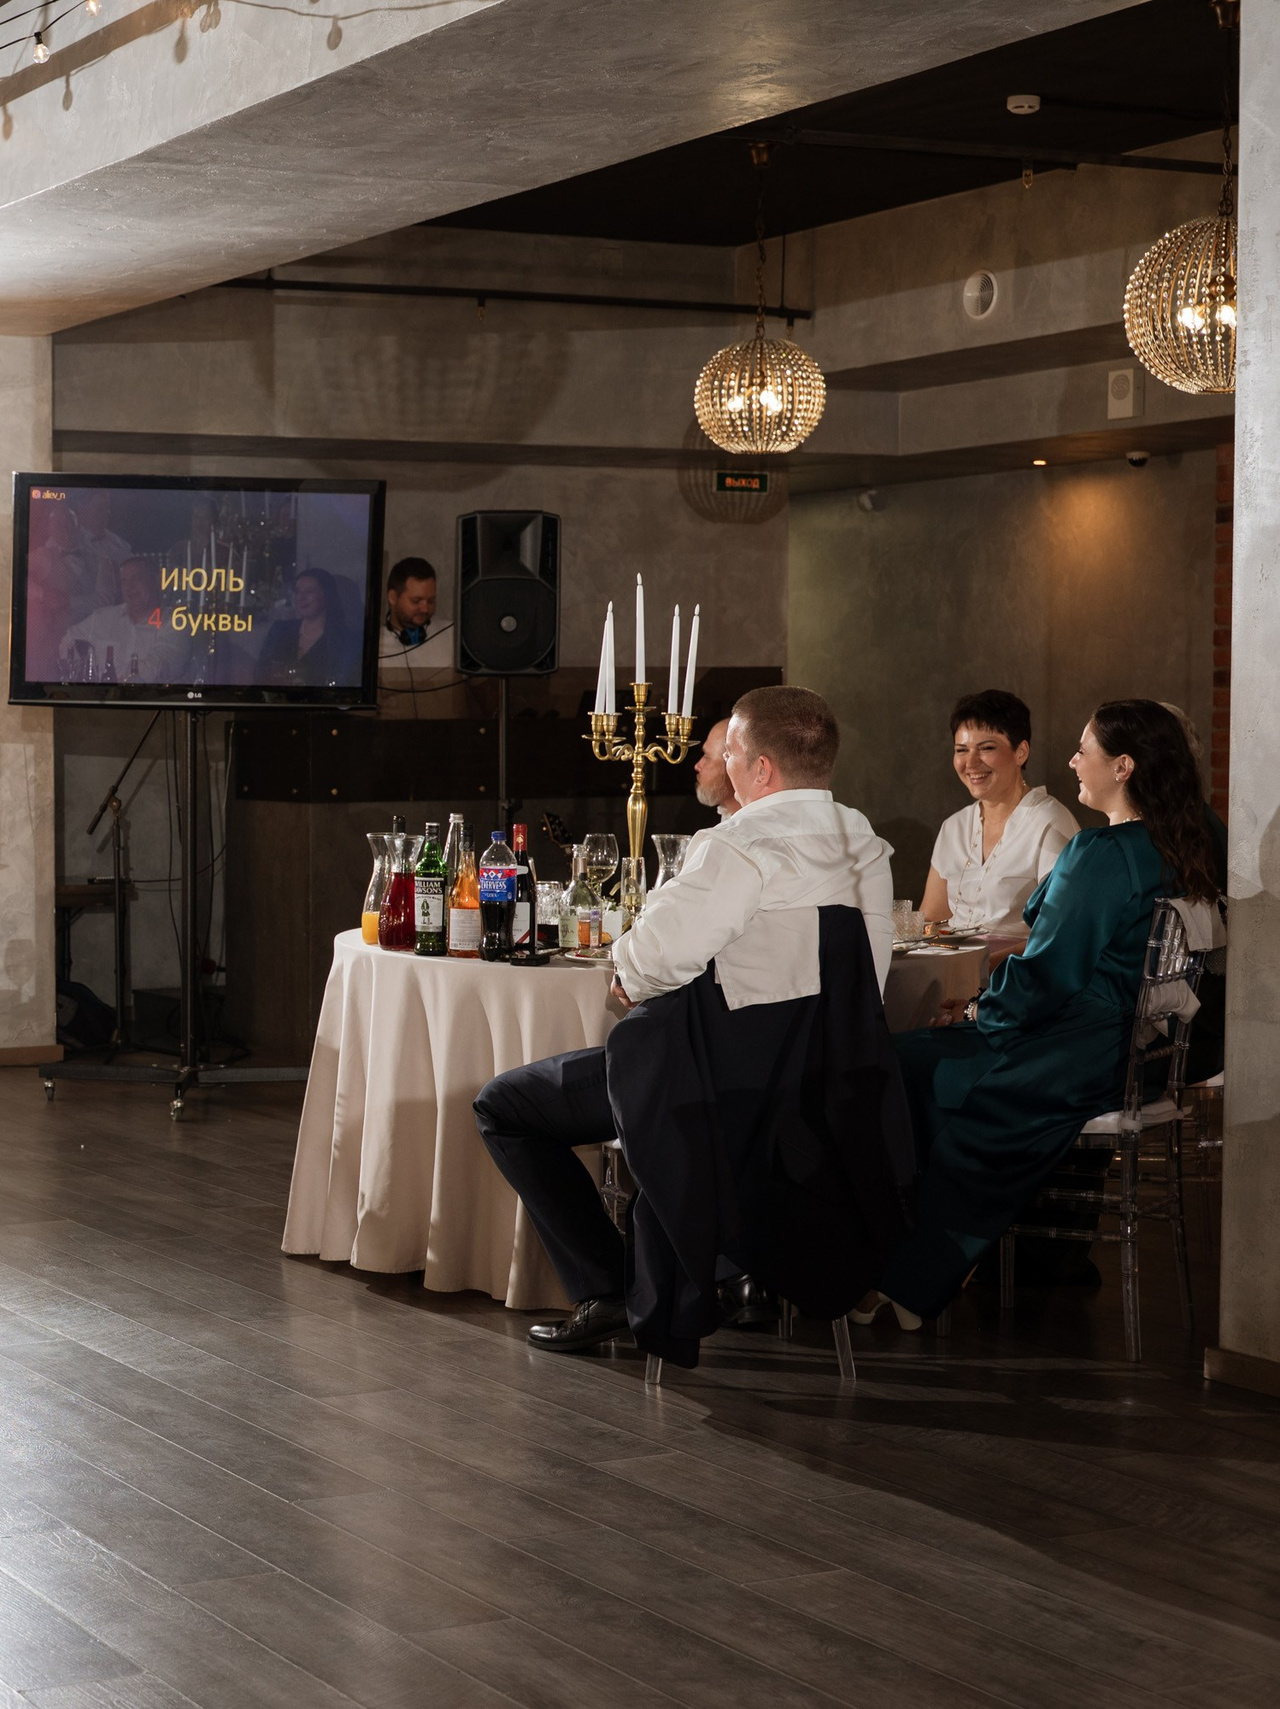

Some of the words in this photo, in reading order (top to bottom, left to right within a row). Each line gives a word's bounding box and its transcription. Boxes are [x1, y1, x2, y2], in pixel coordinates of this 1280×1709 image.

[725, 476, 760, 489] ВЫХОД
[160, 567, 245, 592] ИЮЛЬ
[147, 607, 163, 629] 4
[171, 606, 253, 637] буквы
